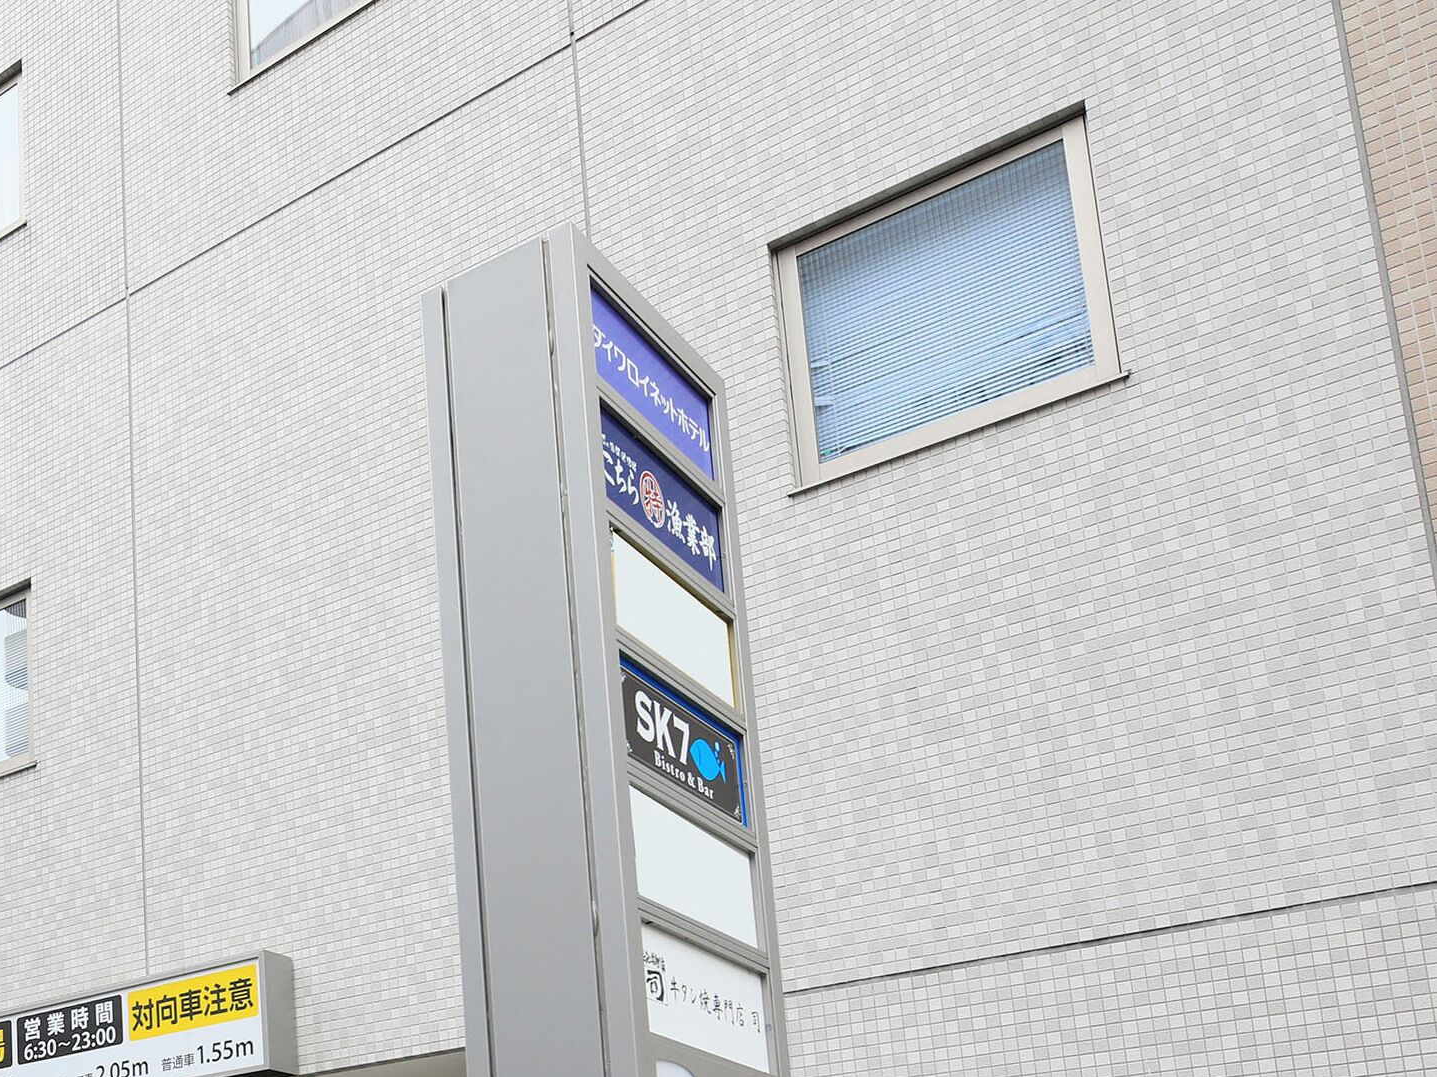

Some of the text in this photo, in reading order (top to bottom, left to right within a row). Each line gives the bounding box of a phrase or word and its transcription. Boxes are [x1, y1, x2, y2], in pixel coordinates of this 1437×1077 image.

[666, 500, 716, 571] 漁業部
[635, 691, 690, 765] SK7
[654, 750, 714, 799] Bistro & Bar
[24, 1000, 113, 1042] 営業時間
[132, 978, 253, 1032] 対向車注意
[161, 1054, 195, 1072] 普通車
[197, 1039, 254, 1065] 1.55m
